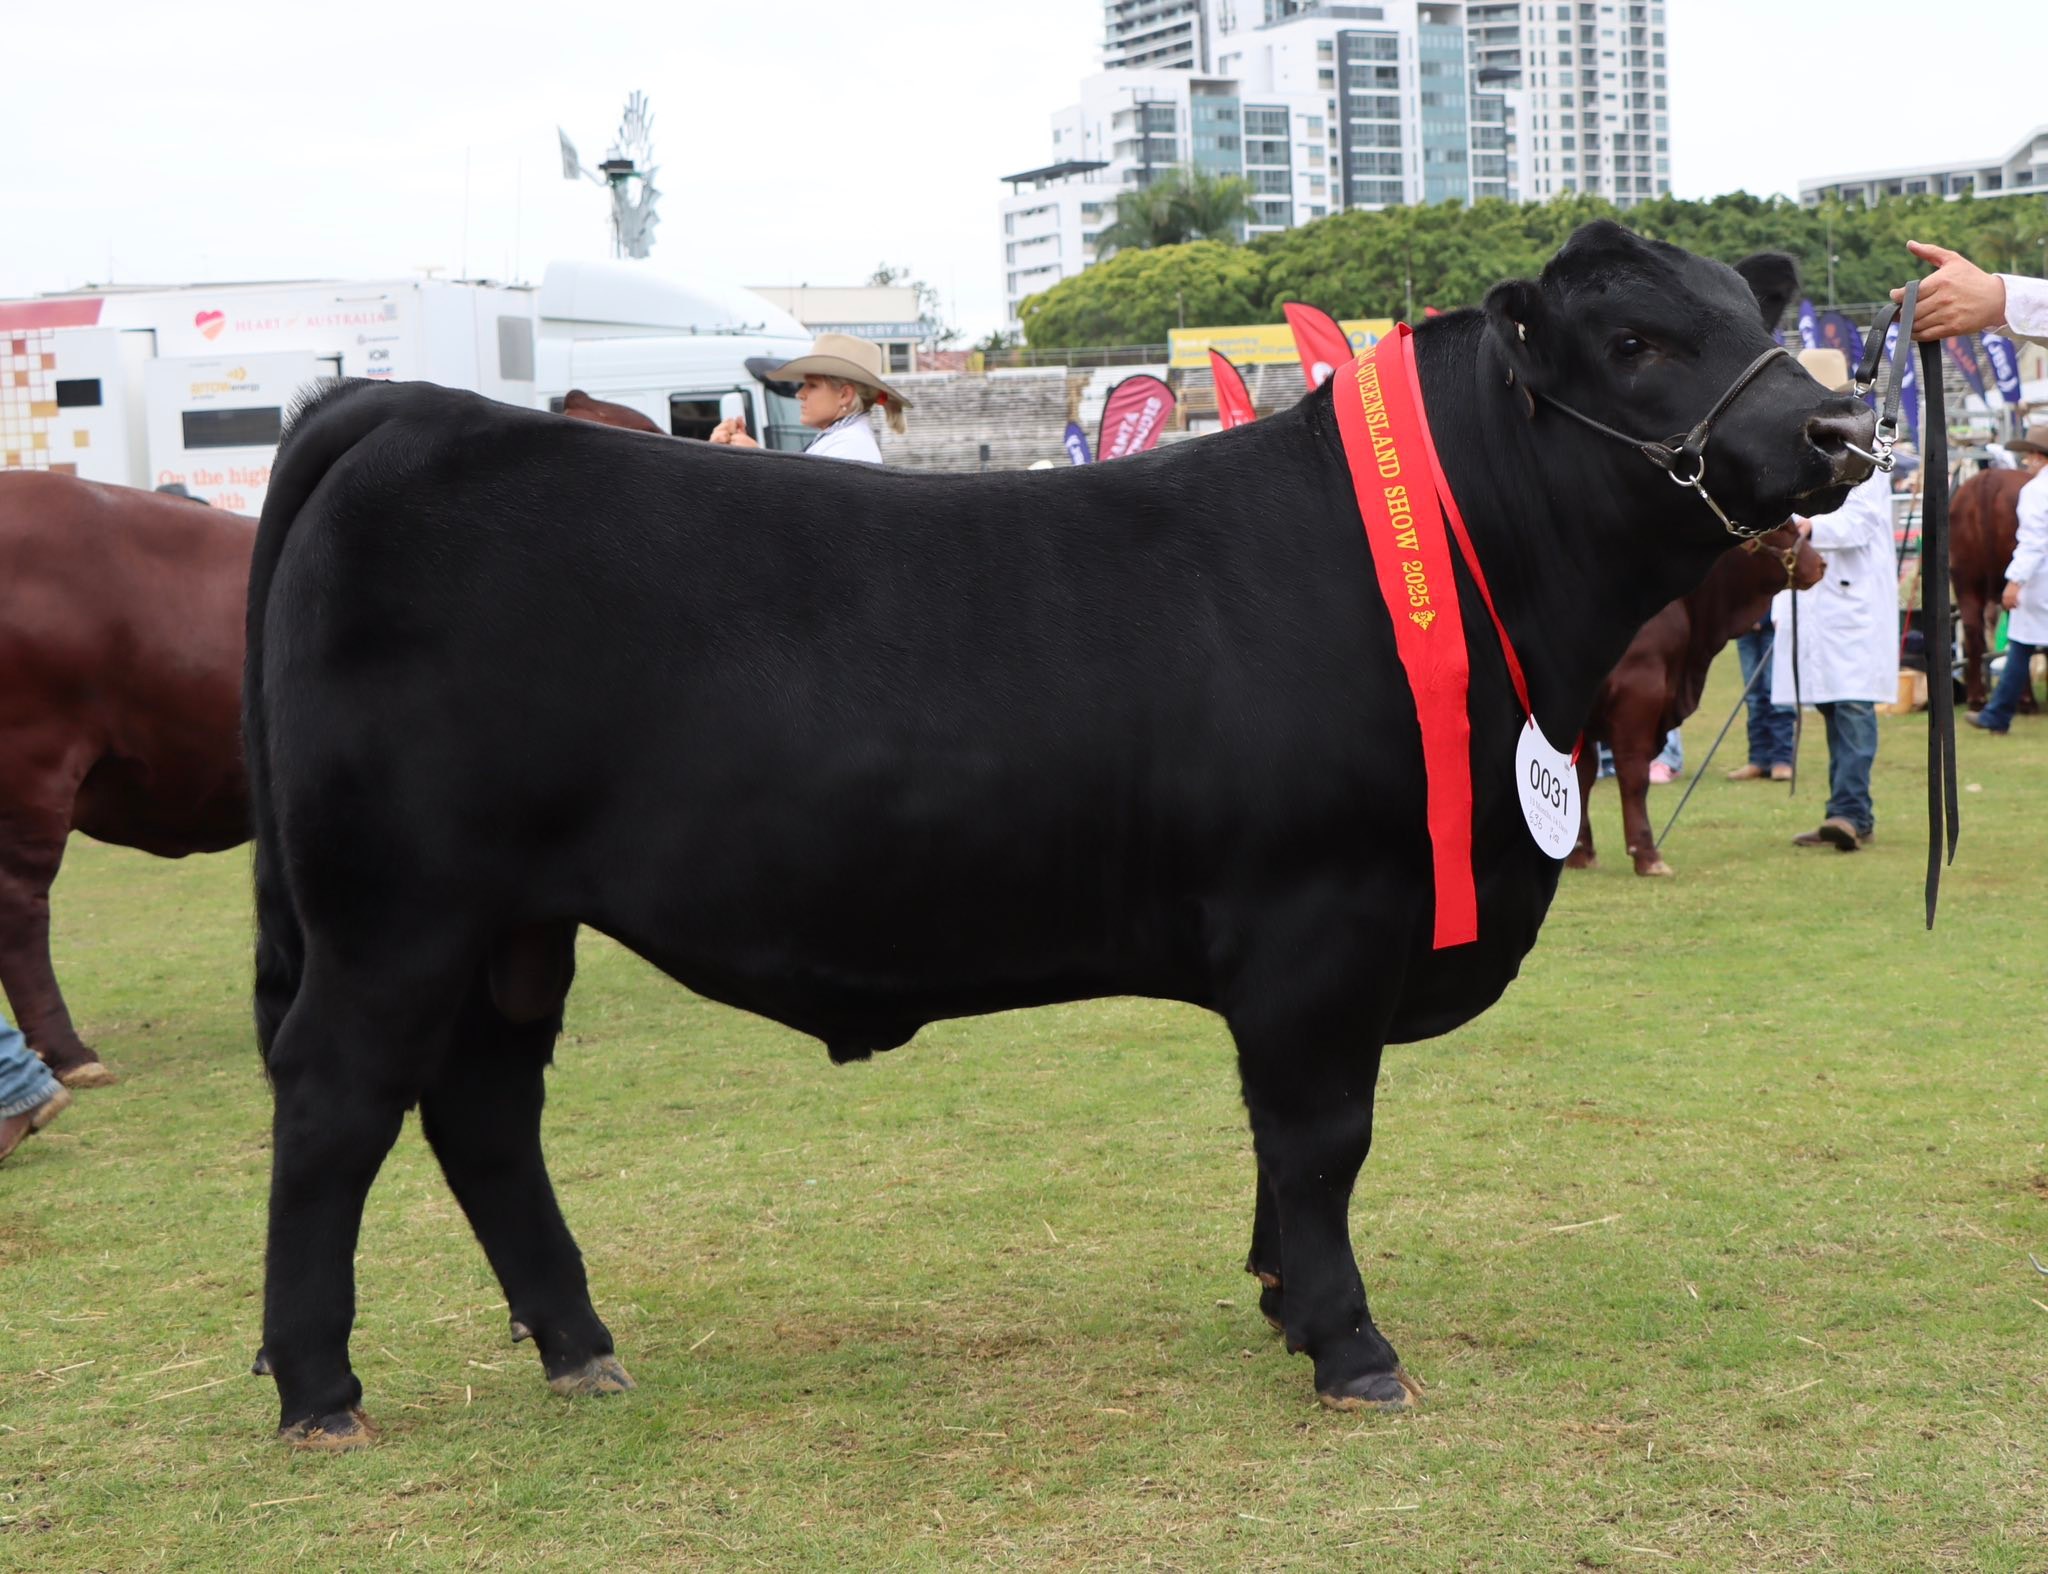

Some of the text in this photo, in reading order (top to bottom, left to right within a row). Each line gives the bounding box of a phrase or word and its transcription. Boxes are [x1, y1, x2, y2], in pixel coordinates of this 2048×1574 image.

[235, 319, 280, 332] HEART
[307, 312, 386, 327] AUSTRALIA
[898, 322, 931, 335] HILL
[1107, 412, 1140, 459] ANTA
[193, 468, 224, 485] the
[1355, 362, 1401, 479] QUEENSLAND
[1384, 485, 1419, 551] SHOW
[1402, 560, 1430, 607] 2025
[1531, 759, 1567, 816] 0031
